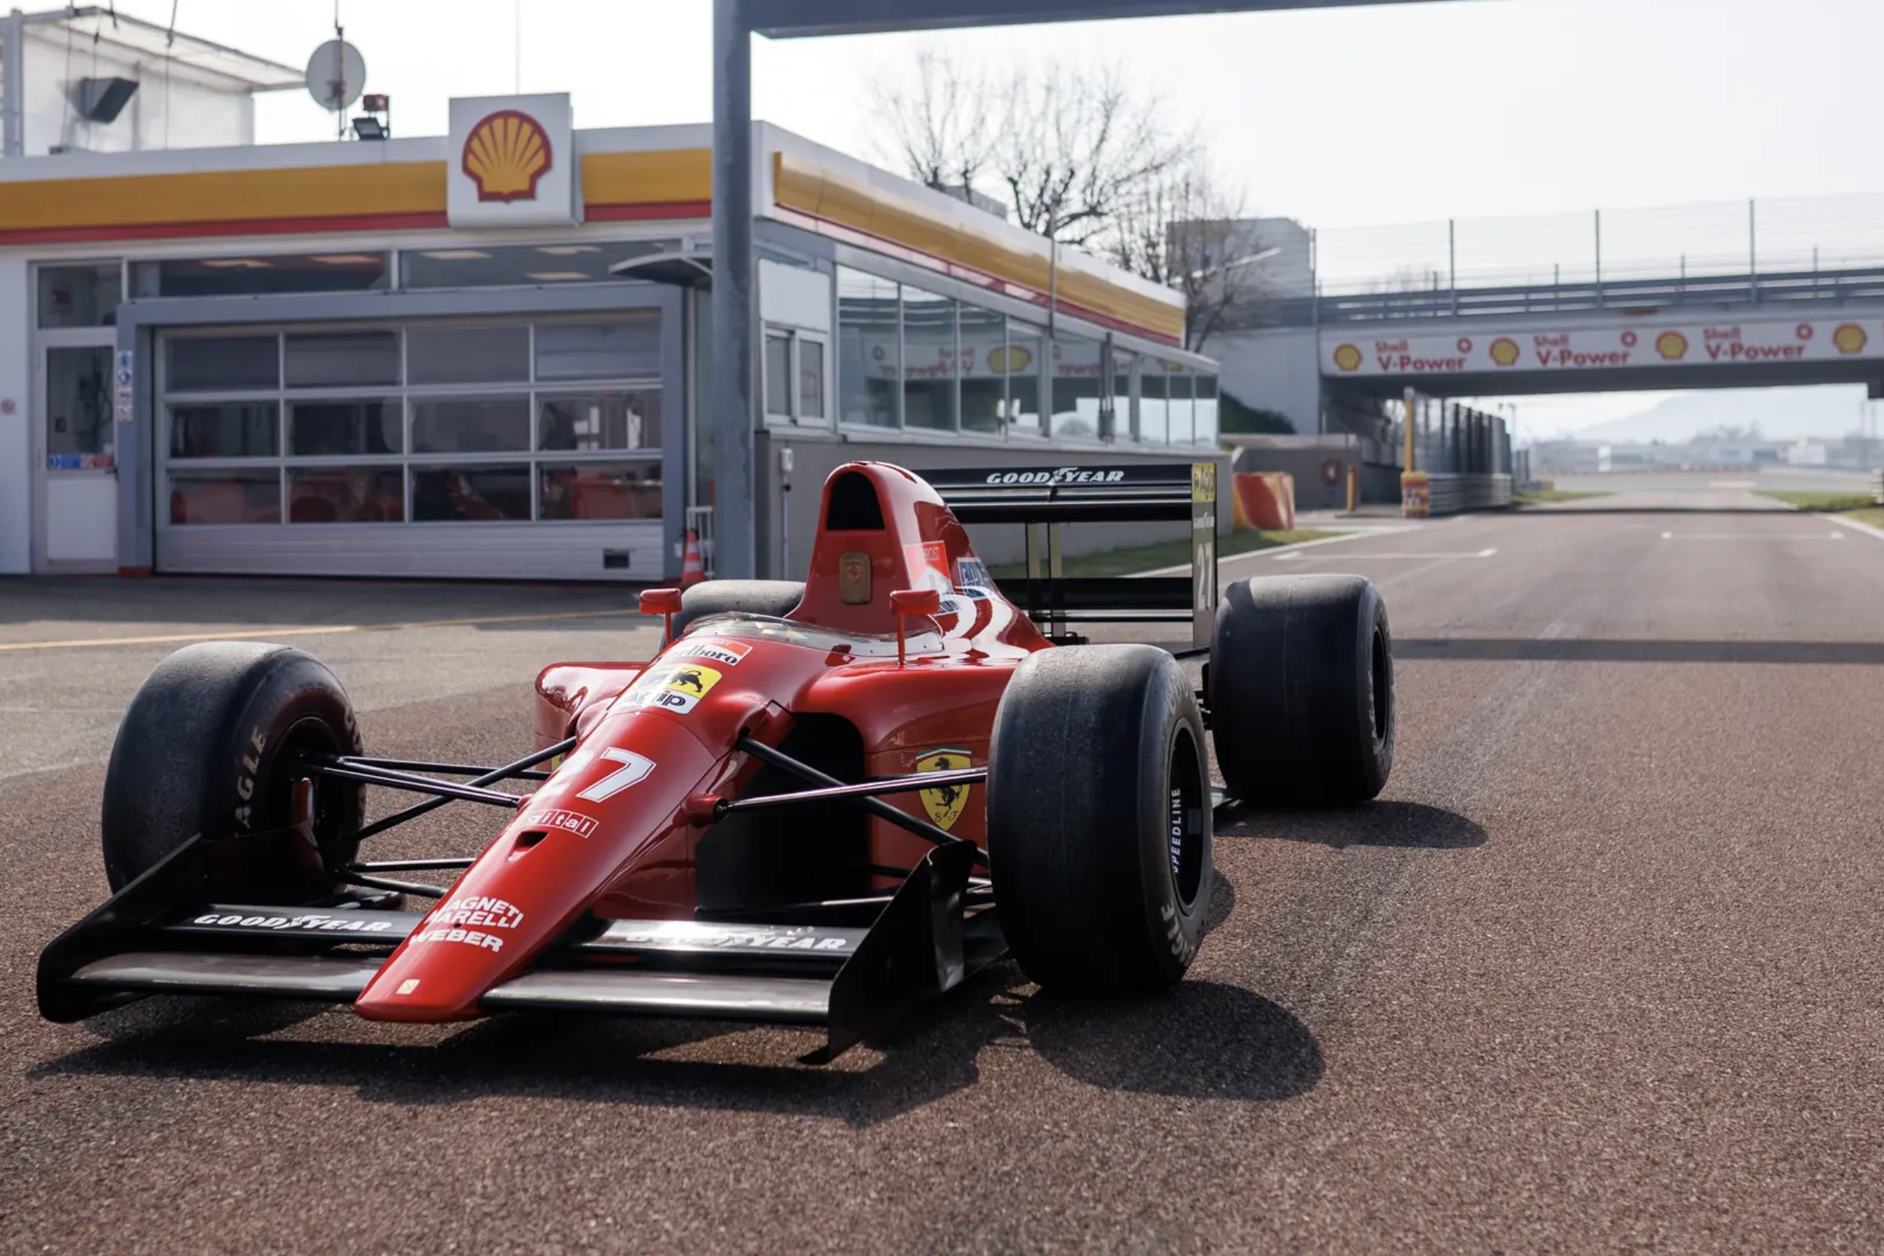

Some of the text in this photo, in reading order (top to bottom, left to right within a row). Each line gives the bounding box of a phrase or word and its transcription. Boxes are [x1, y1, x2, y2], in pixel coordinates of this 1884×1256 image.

[1536, 350, 1630, 366] V-Power
[1705, 343, 1806, 360] V-Power
[1377, 355, 1467, 371] V-Power
[440, 896, 525, 926] AGNETI
